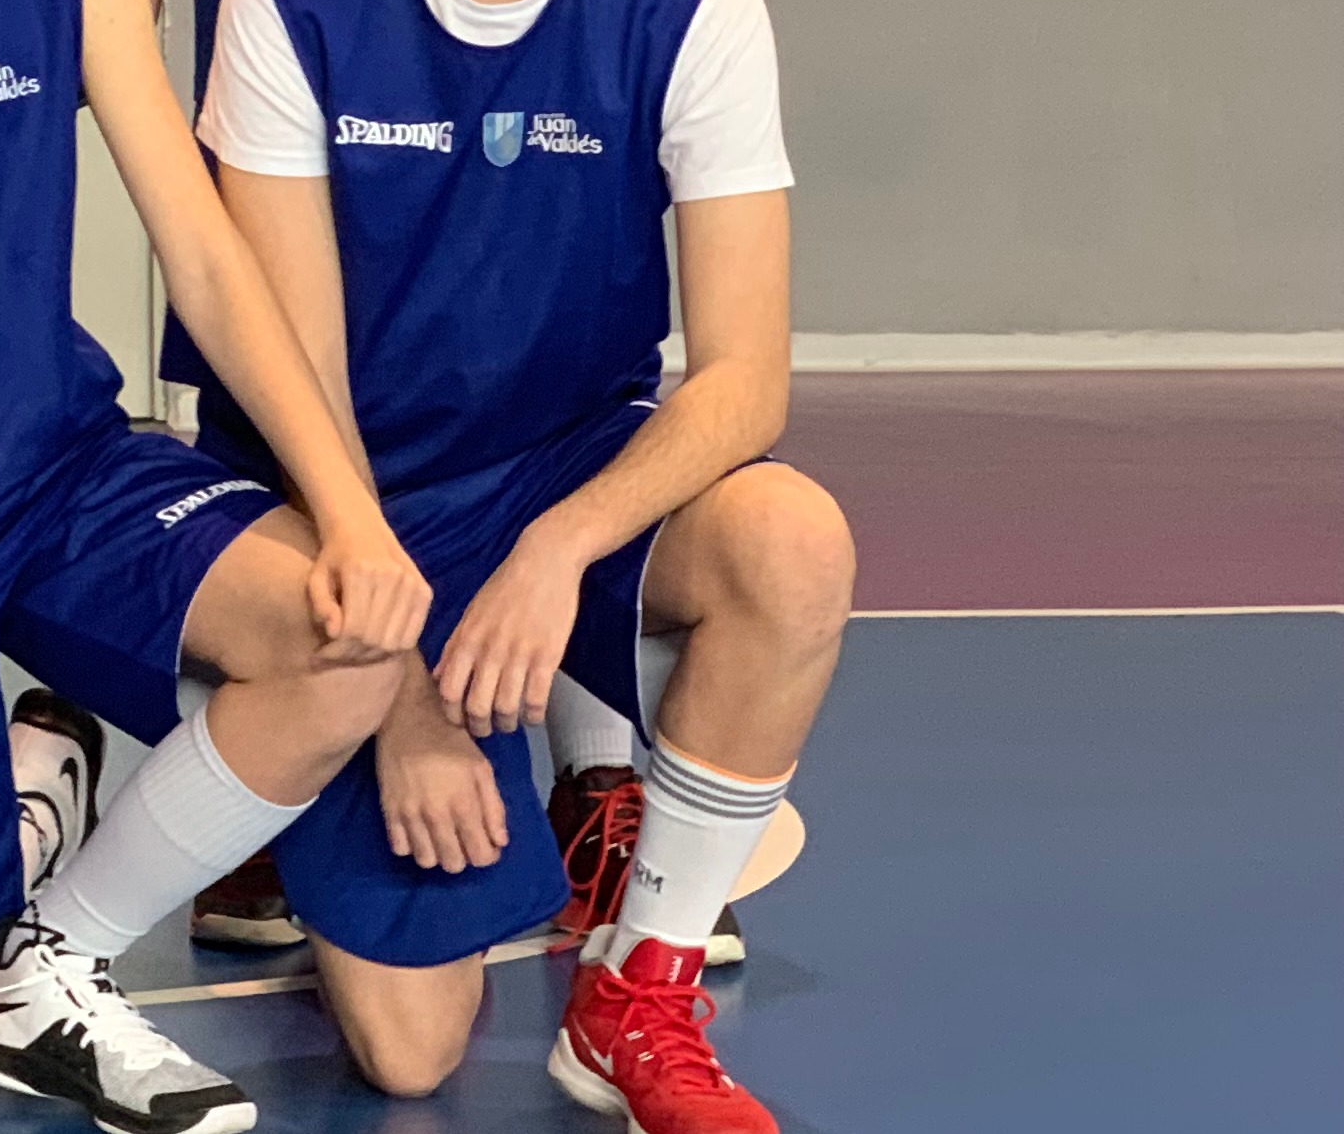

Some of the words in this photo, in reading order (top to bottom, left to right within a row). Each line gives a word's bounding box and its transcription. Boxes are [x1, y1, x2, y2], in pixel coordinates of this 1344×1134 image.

[335, 114, 455, 154] SPALDING
[527, 114, 578, 134] Juan
[538, 132, 604, 154] Valdés
